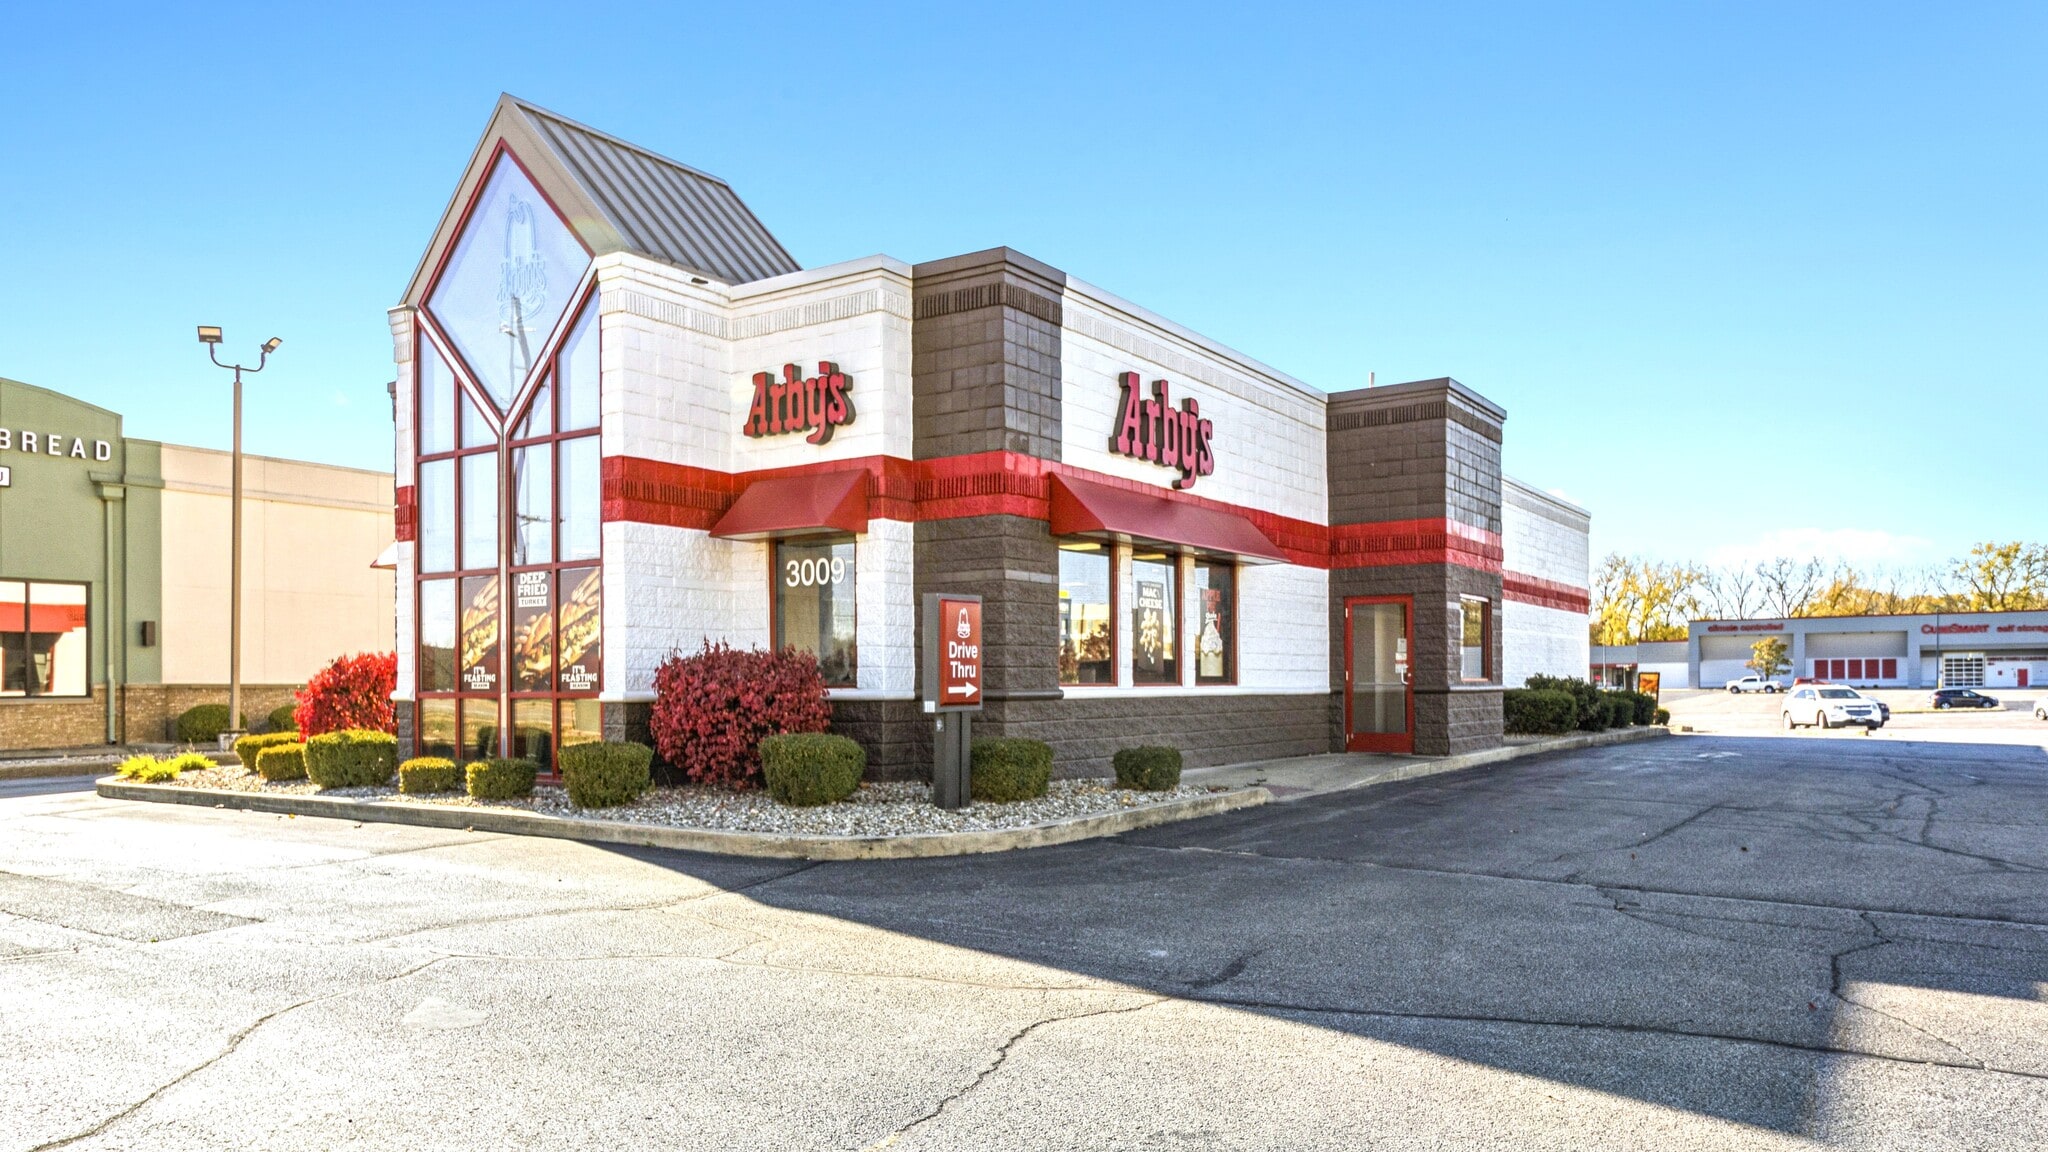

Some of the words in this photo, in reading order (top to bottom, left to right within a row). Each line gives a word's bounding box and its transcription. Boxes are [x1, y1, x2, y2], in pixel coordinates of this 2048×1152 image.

[743, 361, 856, 446] Arby's
[1108, 371, 1214, 490] Arby's
[0, 428, 111, 461] BREAD
[520, 572, 546, 585] DEEP
[786, 557, 846, 588] 3009
[517, 583, 548, 597] FRIED
[948, 641, 978, 659] Drive
[562, 673, 597, 683] FEASTING
[950, 661, 976, 678] Thru
[464, 674, 496, 683] FEASTING
